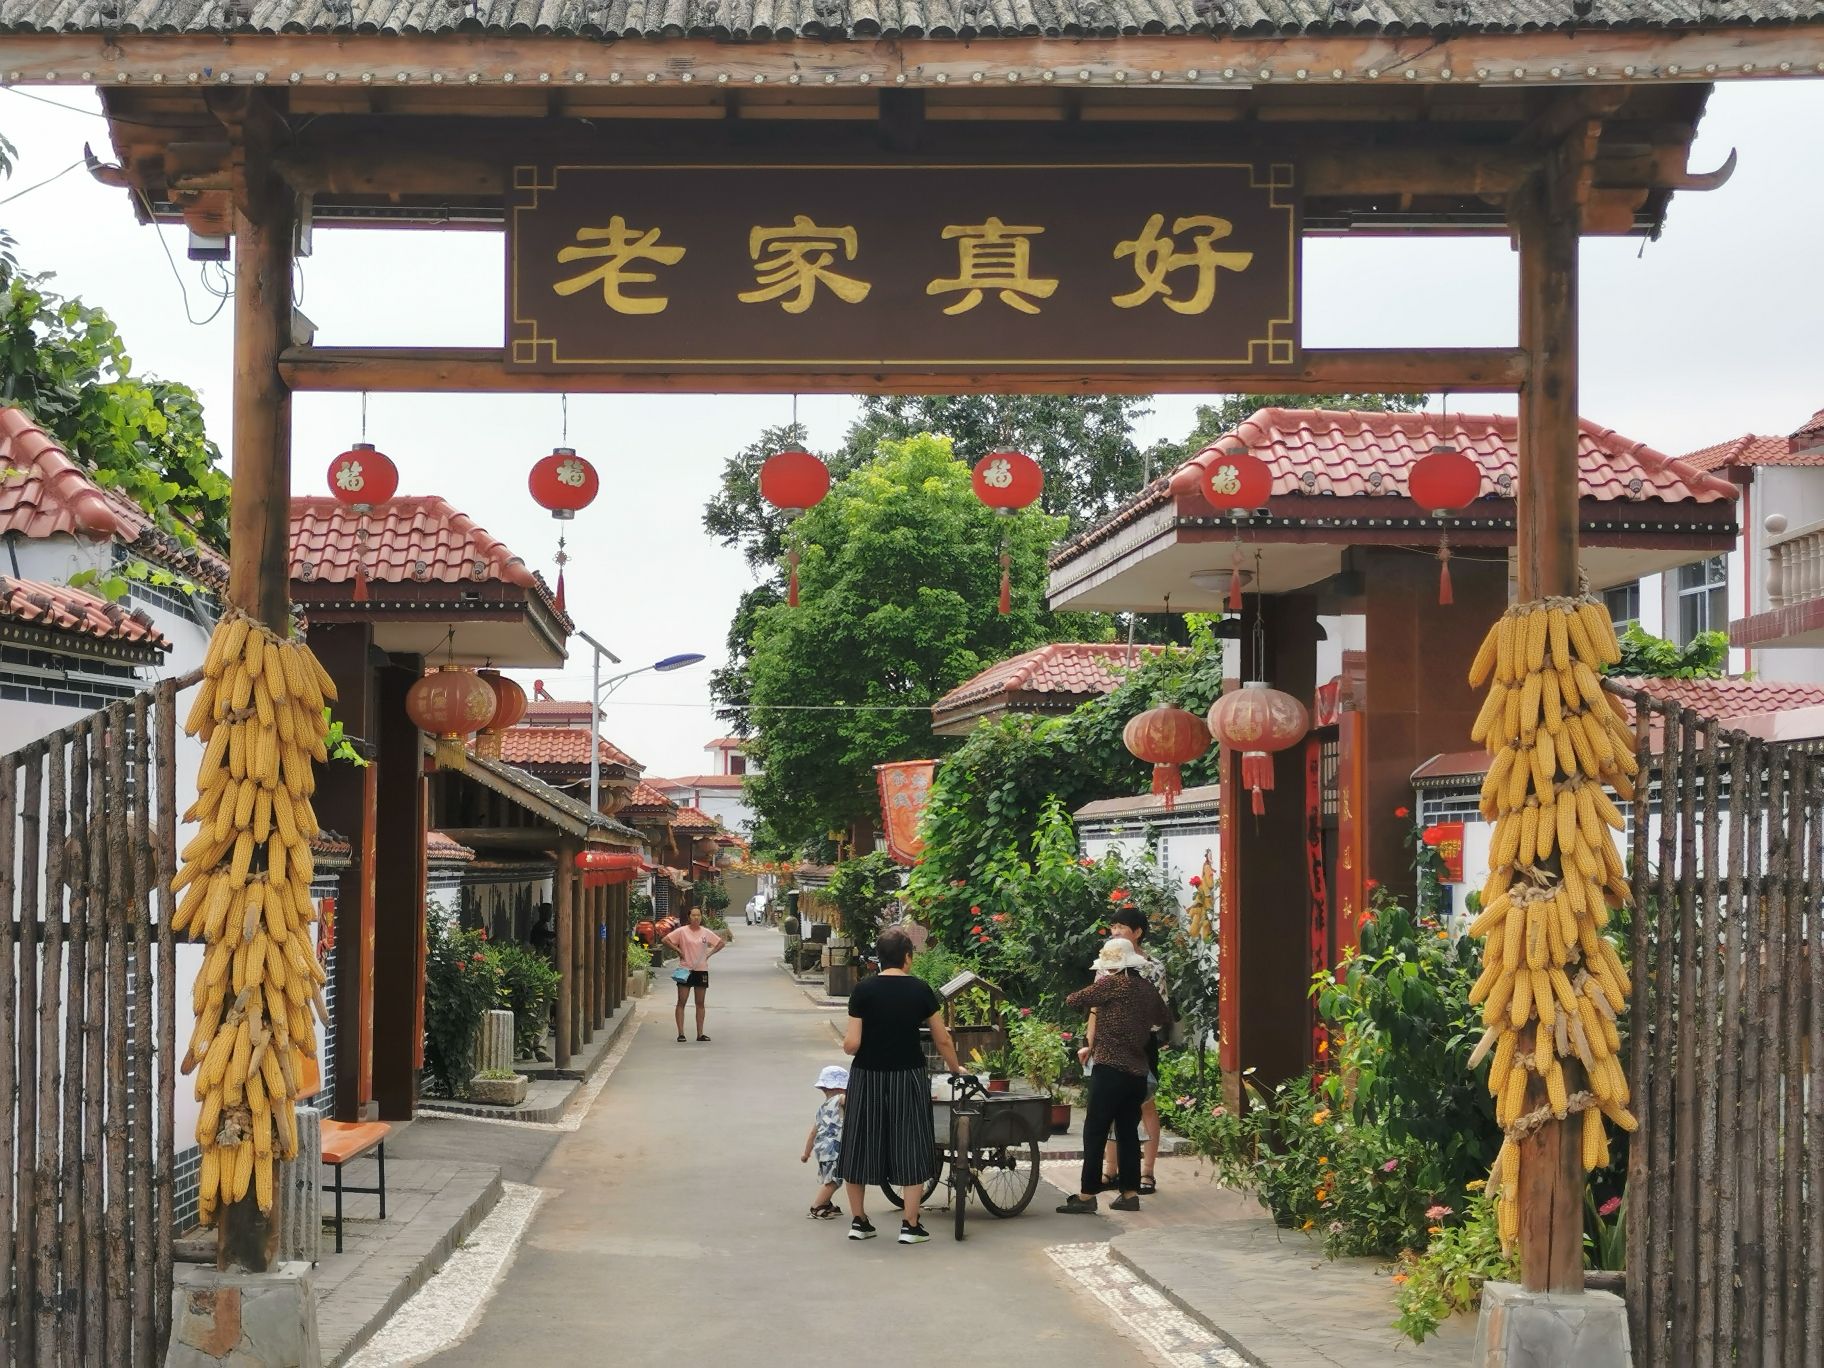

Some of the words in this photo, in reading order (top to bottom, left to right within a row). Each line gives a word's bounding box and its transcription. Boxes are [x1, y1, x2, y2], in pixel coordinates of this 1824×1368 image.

[552, 213, 1254, 316] 老家真好
[335, 460, 365, 492] 福
[556, 459, 586, 488] 福
[982, 459, 1013, 488] 福
[1211, 464, 1242, 496] 福
